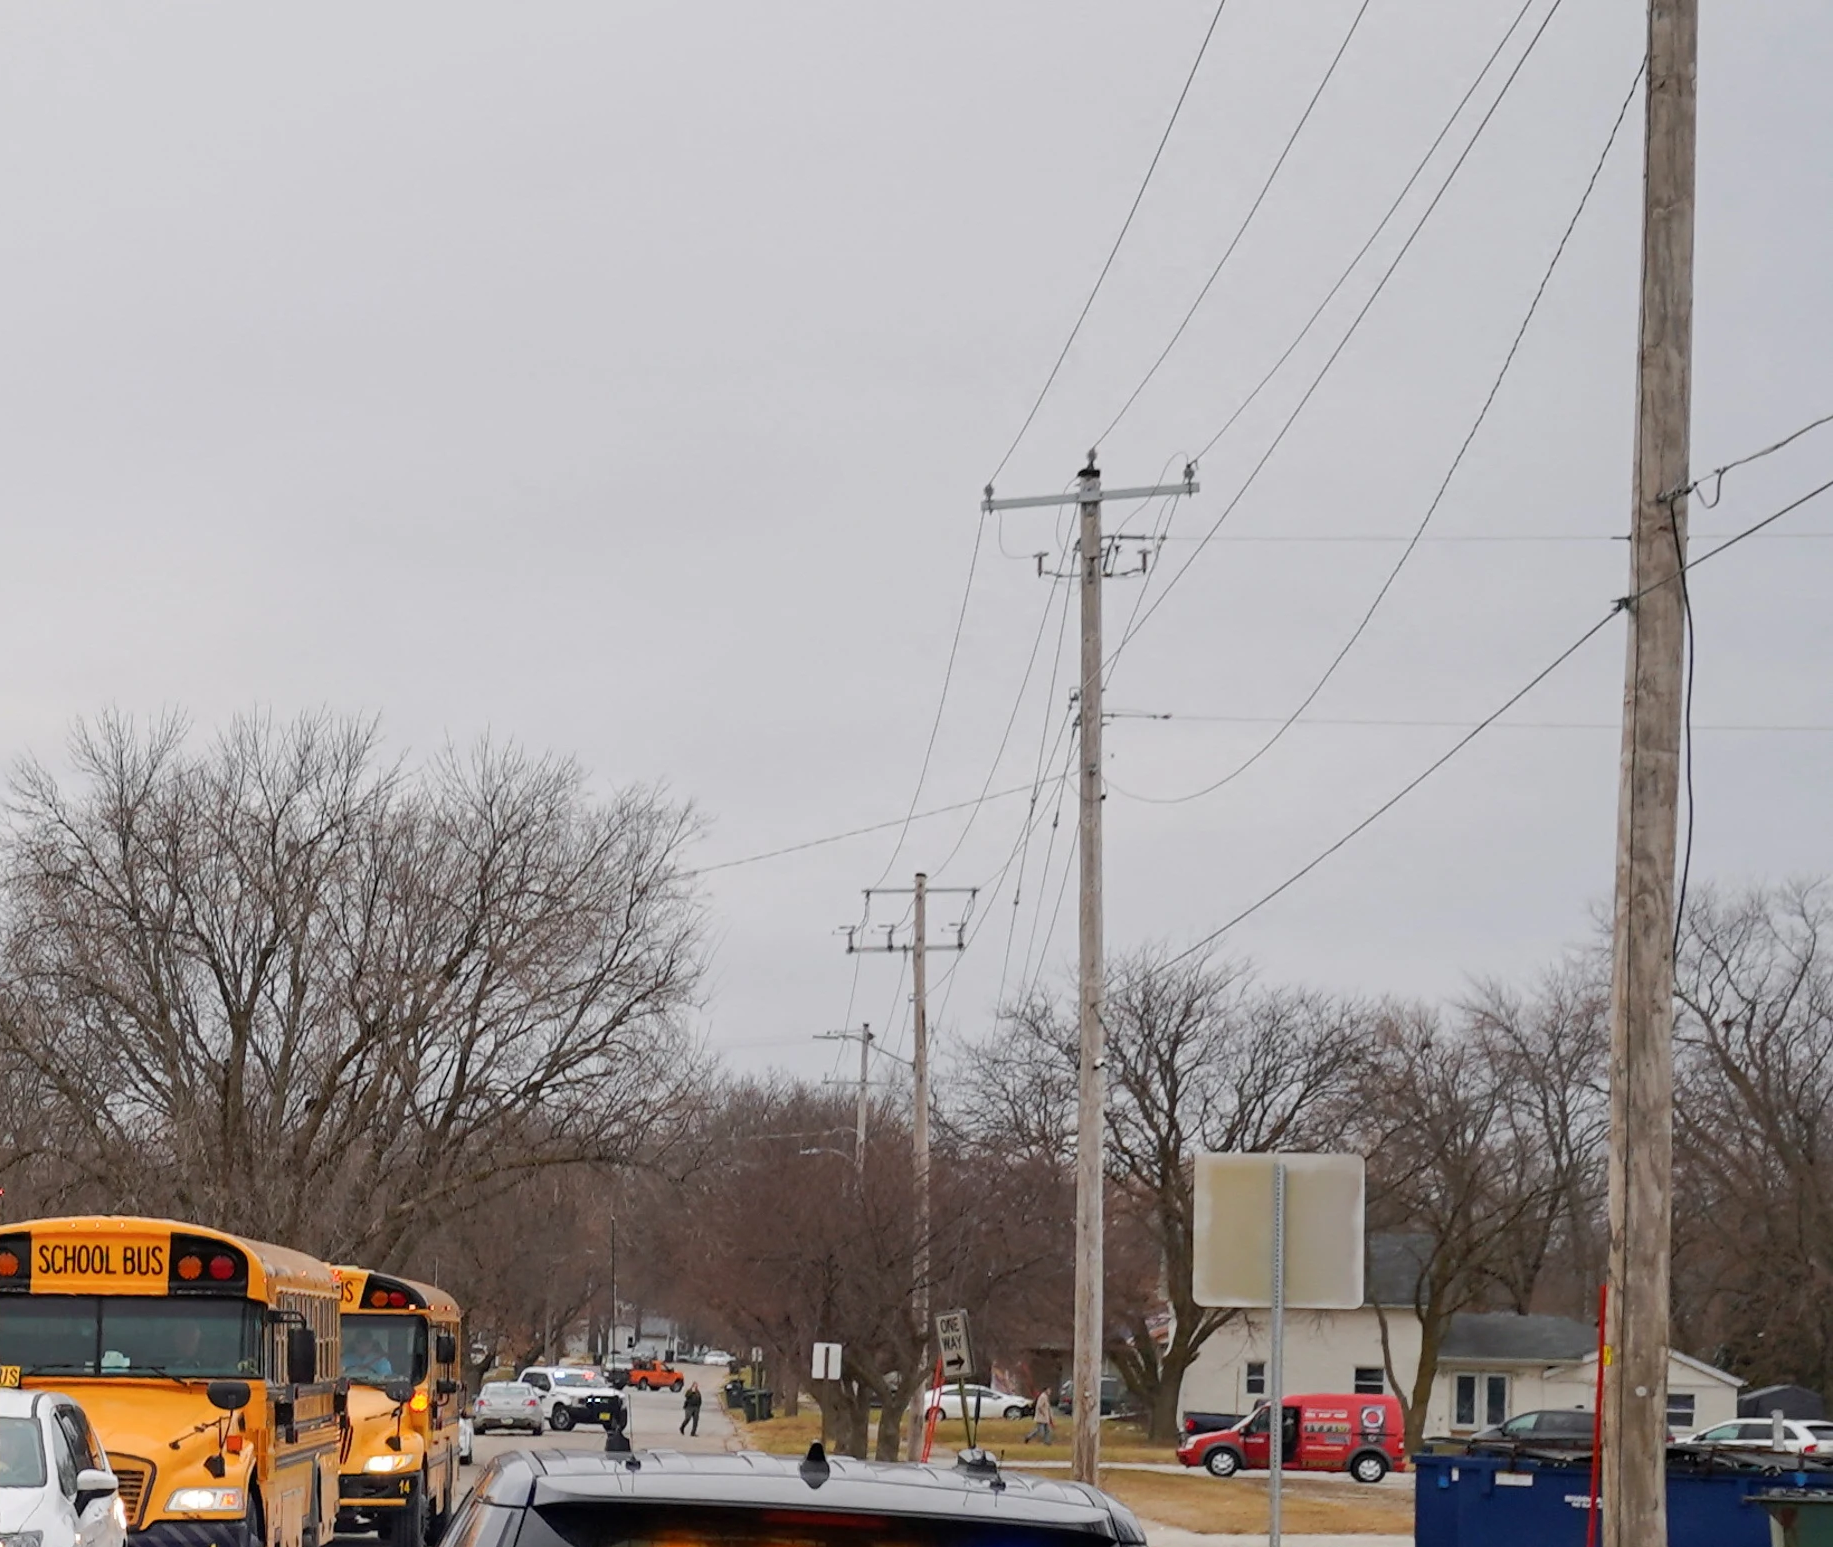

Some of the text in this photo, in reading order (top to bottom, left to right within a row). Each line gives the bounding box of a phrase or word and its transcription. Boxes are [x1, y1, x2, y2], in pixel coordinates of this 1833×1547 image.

[39, 1245, 163, 1275] SCHOOL BUS
[940, 1317, 959, 1333] ONE
[941, 1335, 961, 1352] WAY
[398, 1479, 411, 1494] 14
